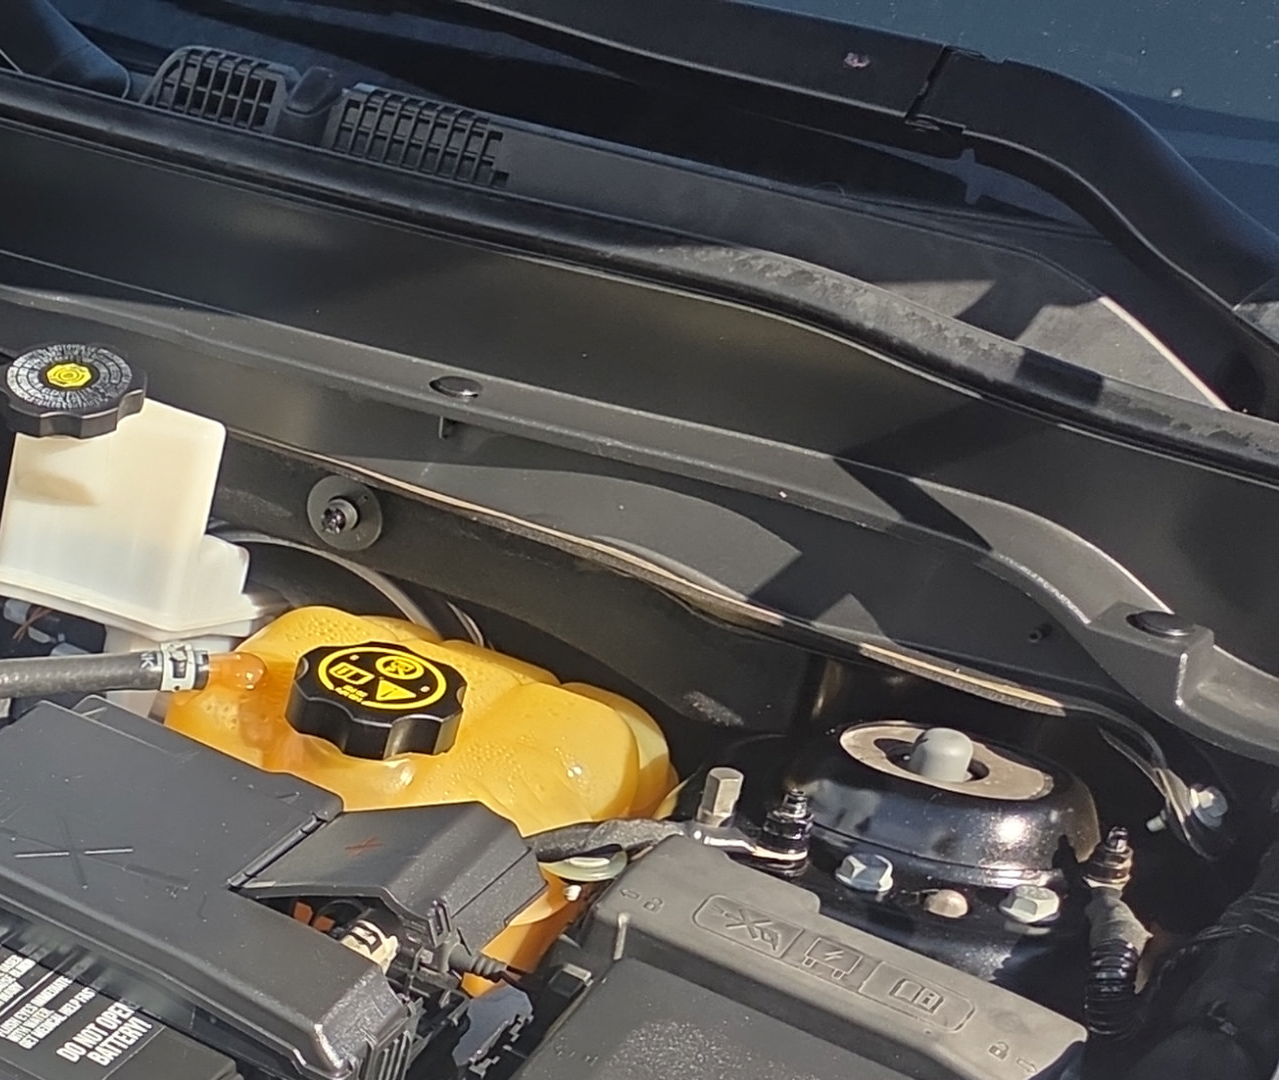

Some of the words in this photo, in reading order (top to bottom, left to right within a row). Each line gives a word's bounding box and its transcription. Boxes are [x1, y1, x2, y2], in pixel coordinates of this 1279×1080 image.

[12, 1002, 40, 1022] EYES
[29, 974, 73, 1008] IMMEDIATE
[17, 1033, 40, 1049] GET
[30, 1010, 68, 1039] MEDICAL
[57, 997, 84, 1017] HELP
[73, 985, 98, 1003] FAS
[5, 1024, 31, 1043] WITH
[56, 1042, 86, 1064] DO
[72, 1023, 103, 1049] NOT
